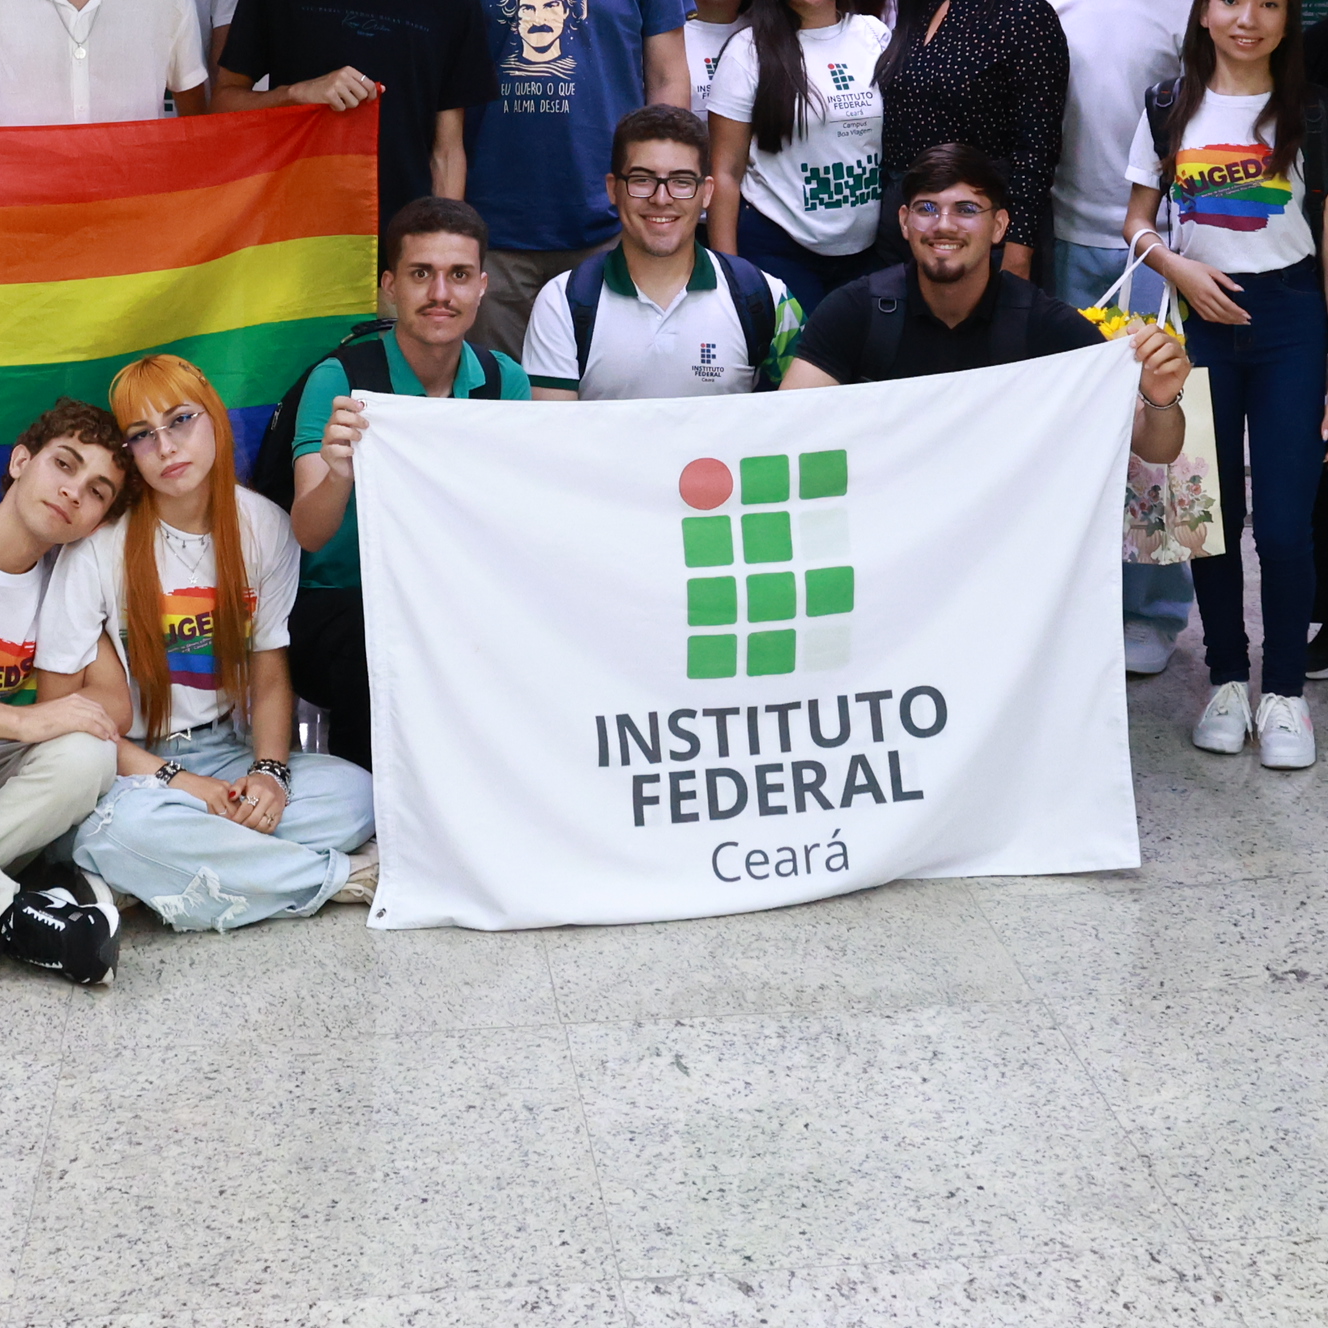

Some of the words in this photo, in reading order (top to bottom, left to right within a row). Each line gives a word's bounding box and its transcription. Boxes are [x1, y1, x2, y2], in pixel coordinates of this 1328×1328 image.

[500, 83, 512, 96] EU
[515, 82, 543, 96] QUERO
[547, 82, 554, 96] O
[558, 82, 576, 97] QUE
[827, 91, 874, 104] INSTITUTO
[833, 100, 872, 110] FEDERAL
[503, 100, 509, 114] A
[513, 99, 535, 114] ALMA
[539, 99, 570, 114] DESEJA
[692, 365, 725, 373] INSTITUTO
[595, 685, 948, 768] INSTITUTO
[631, 750, 925, 828] FEDERAL
[711, 828, 850, 883] Ceará
